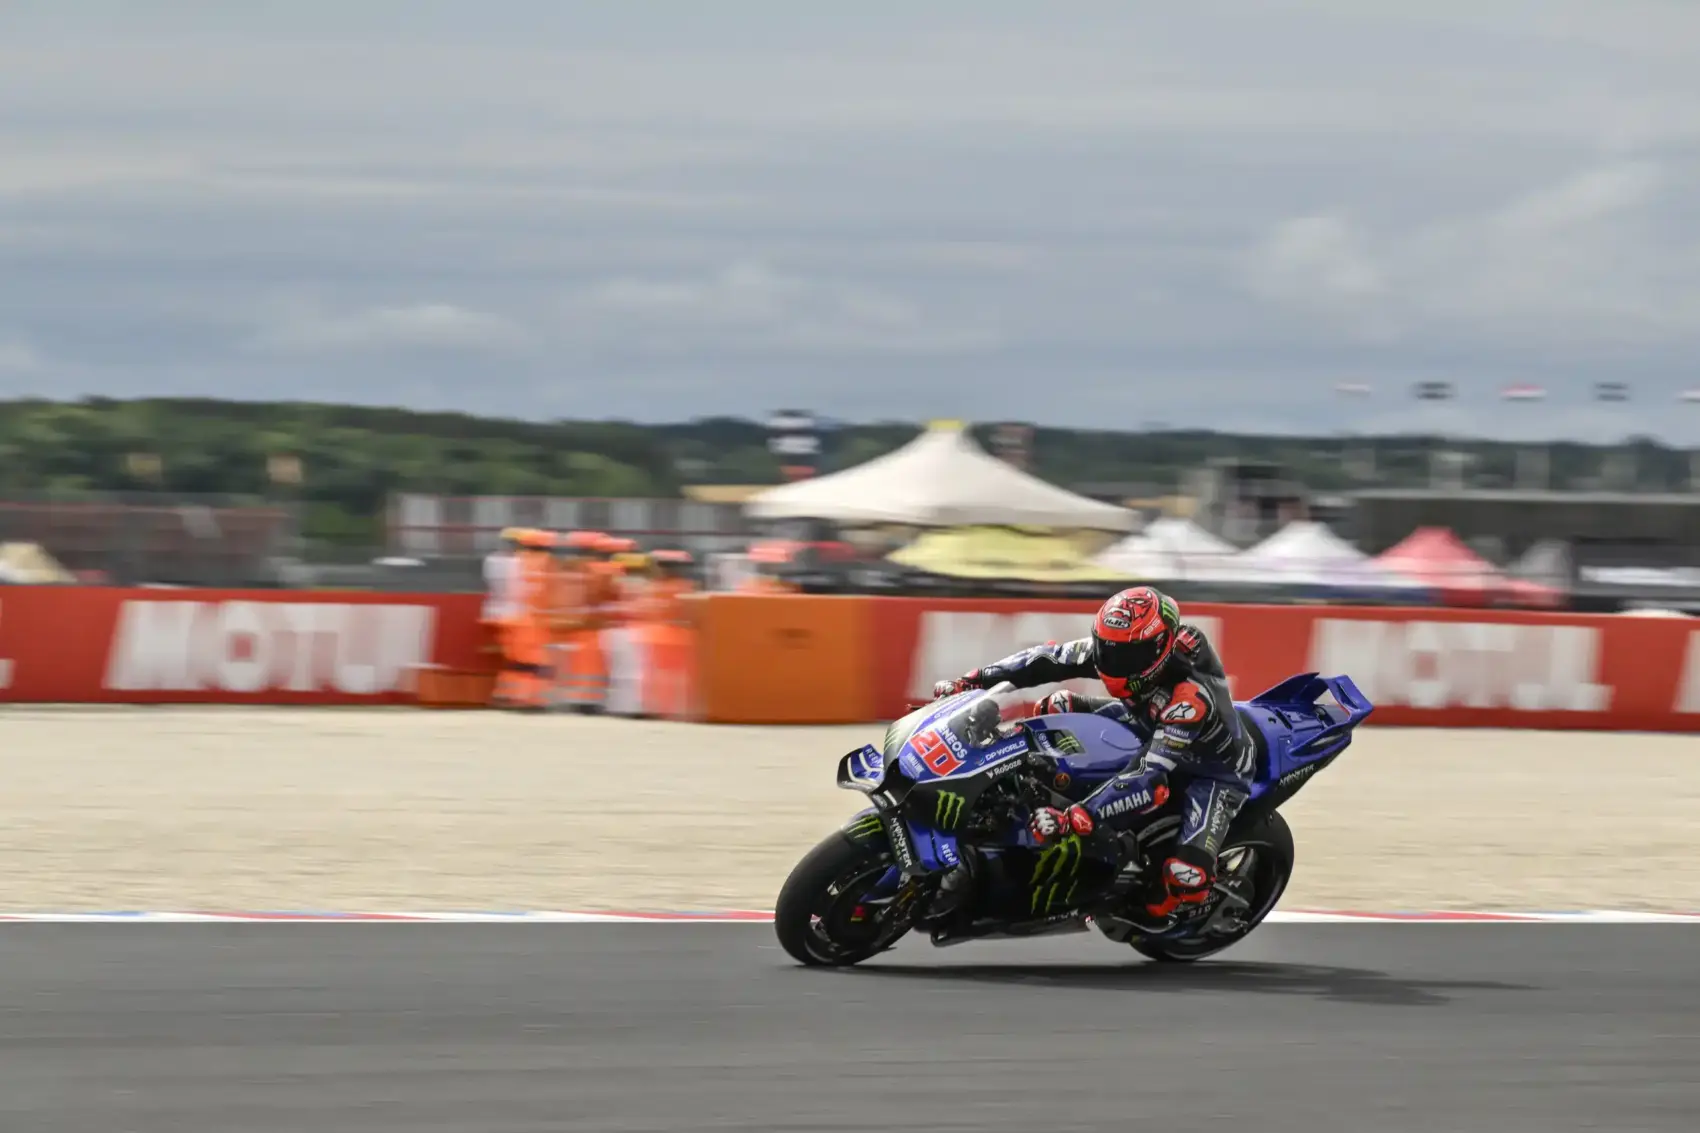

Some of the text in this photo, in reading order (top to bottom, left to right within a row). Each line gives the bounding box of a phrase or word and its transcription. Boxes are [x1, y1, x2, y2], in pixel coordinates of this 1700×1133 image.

[909, 729, 964, 777] 20
[985, 740, 1026, 762] DP WORLD
[1279, 764, 1315, 786] MONSTER
[1098, 789, 1152, 819] YAMAHA
[891, 817, 912, 868] MONSTER
